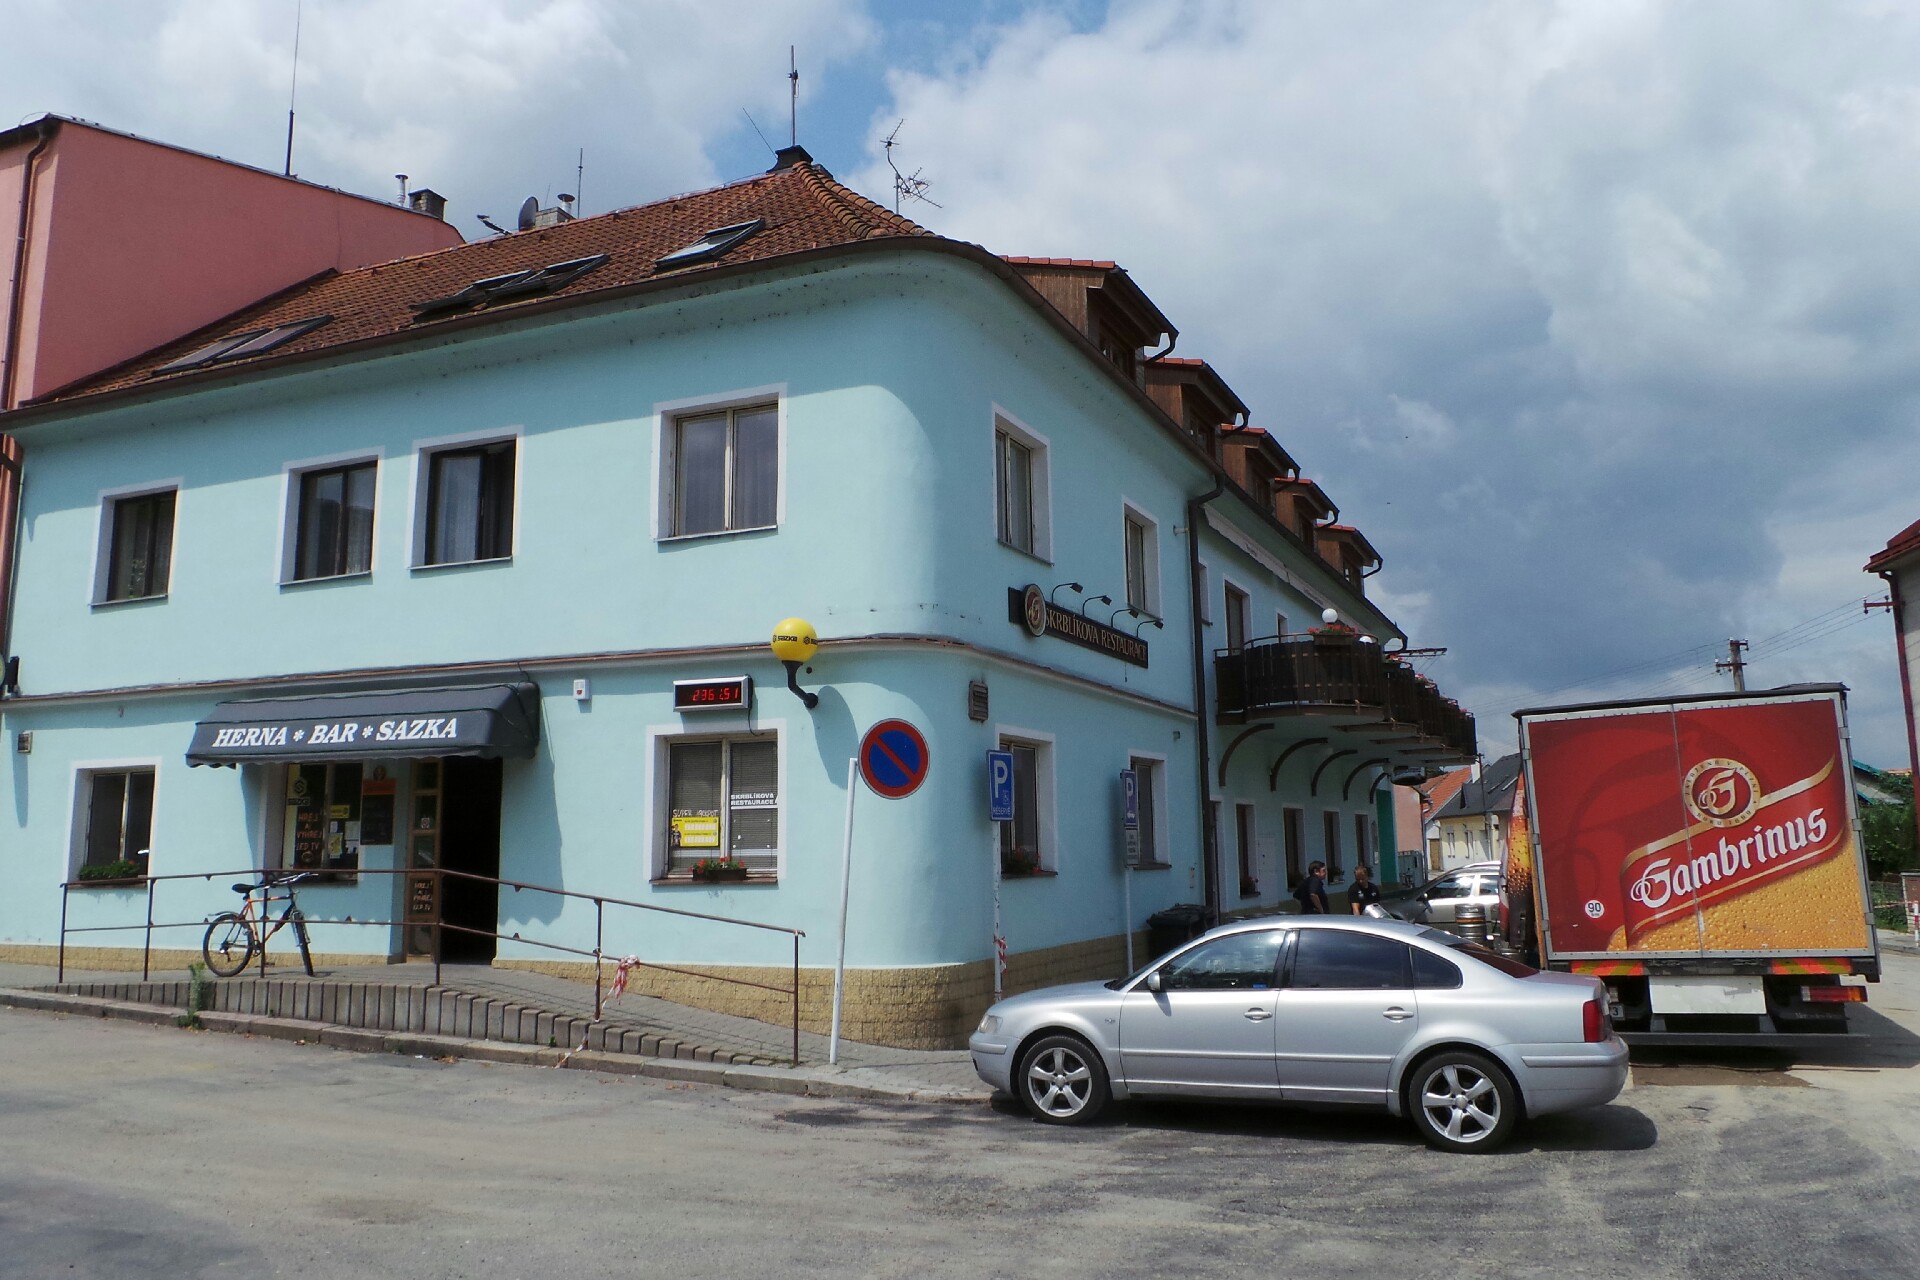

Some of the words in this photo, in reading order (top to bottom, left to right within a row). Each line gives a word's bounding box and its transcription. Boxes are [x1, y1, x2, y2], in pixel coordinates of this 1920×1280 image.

[1046, 607, 1098, 644] SKRBLÍKOVA
[1101, 629, 1146, 661] RESTAURACE
[211, 726, 288, 748] HERNA
[307, 723, 358, 745] BAR
[375, 717, 457, 742] SAZKA
[993, 760, 1008, 799] P
[1125, 777, 1134, 809] P
[1630, 807, 1828, 908] Gambrinus
[1587, 902, 1601, 913] 90
